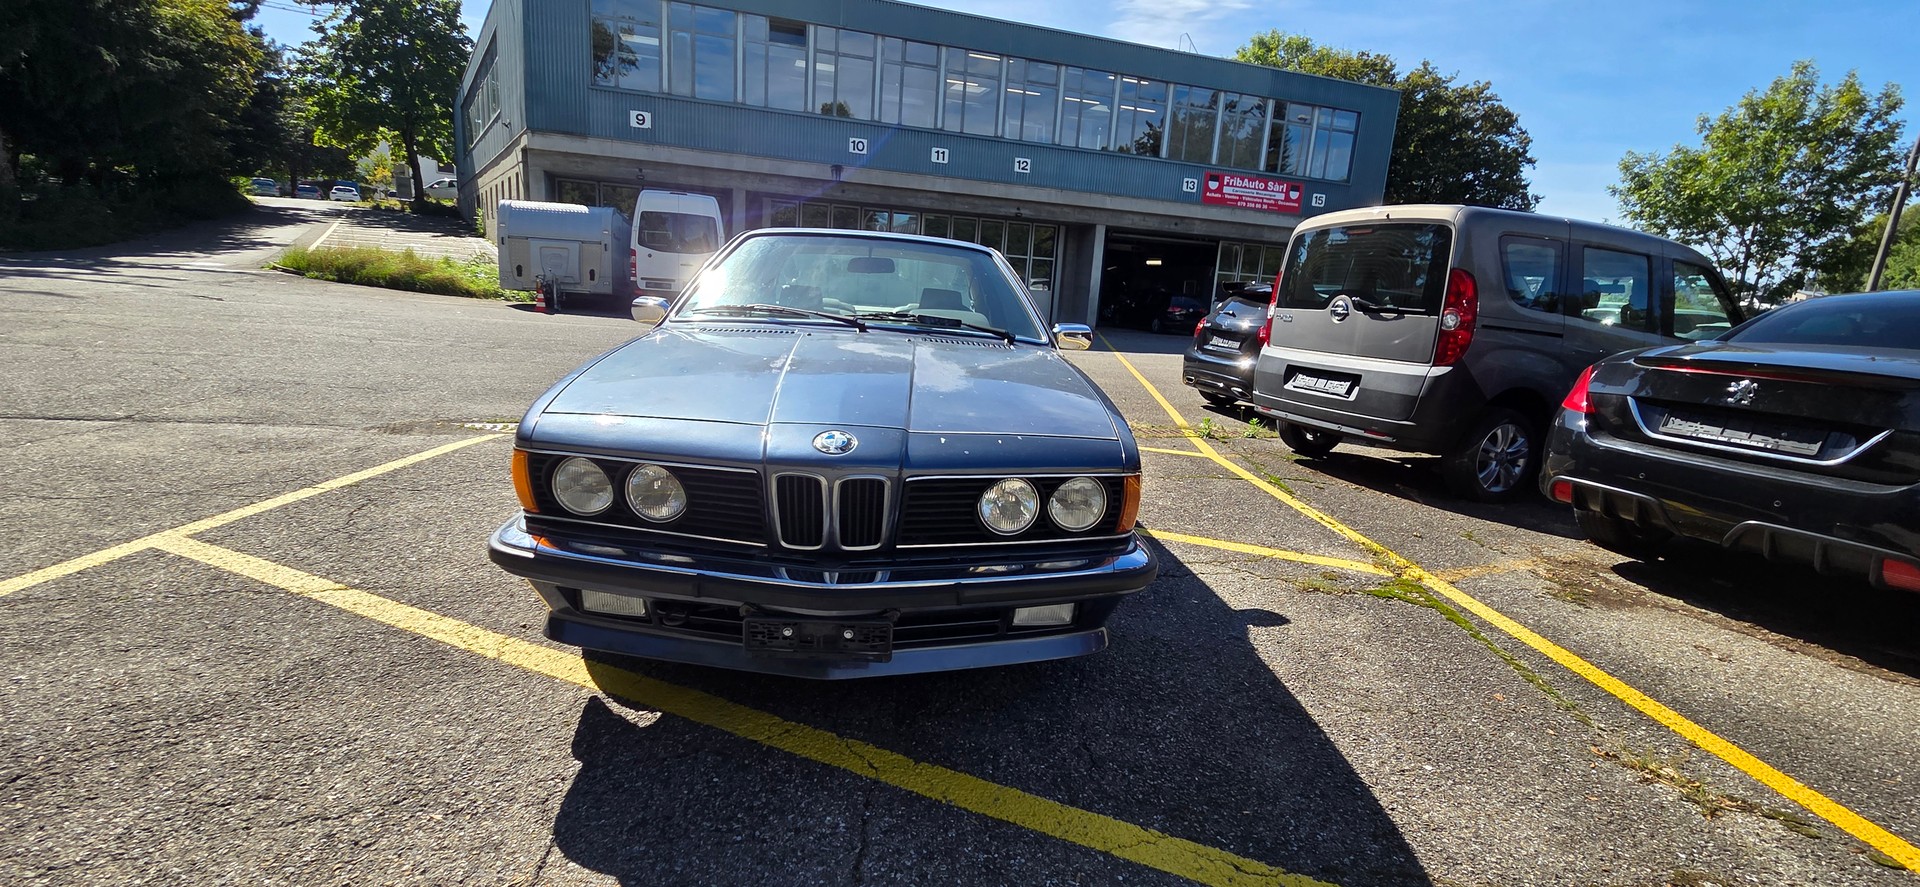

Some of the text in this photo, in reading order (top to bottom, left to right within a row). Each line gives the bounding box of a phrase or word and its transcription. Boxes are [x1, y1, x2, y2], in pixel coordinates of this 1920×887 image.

[636, 113, 646, 126] 9
[850, 140, 865, 152] 10
[934, 150, 946, 161] 11
[1016, 160, 1028, 170] 12
[1185, 180, 1196, 190] 13
[1224, 176, 1265, 190] FribAuto
[1314, 196, 1324, 205] 15
